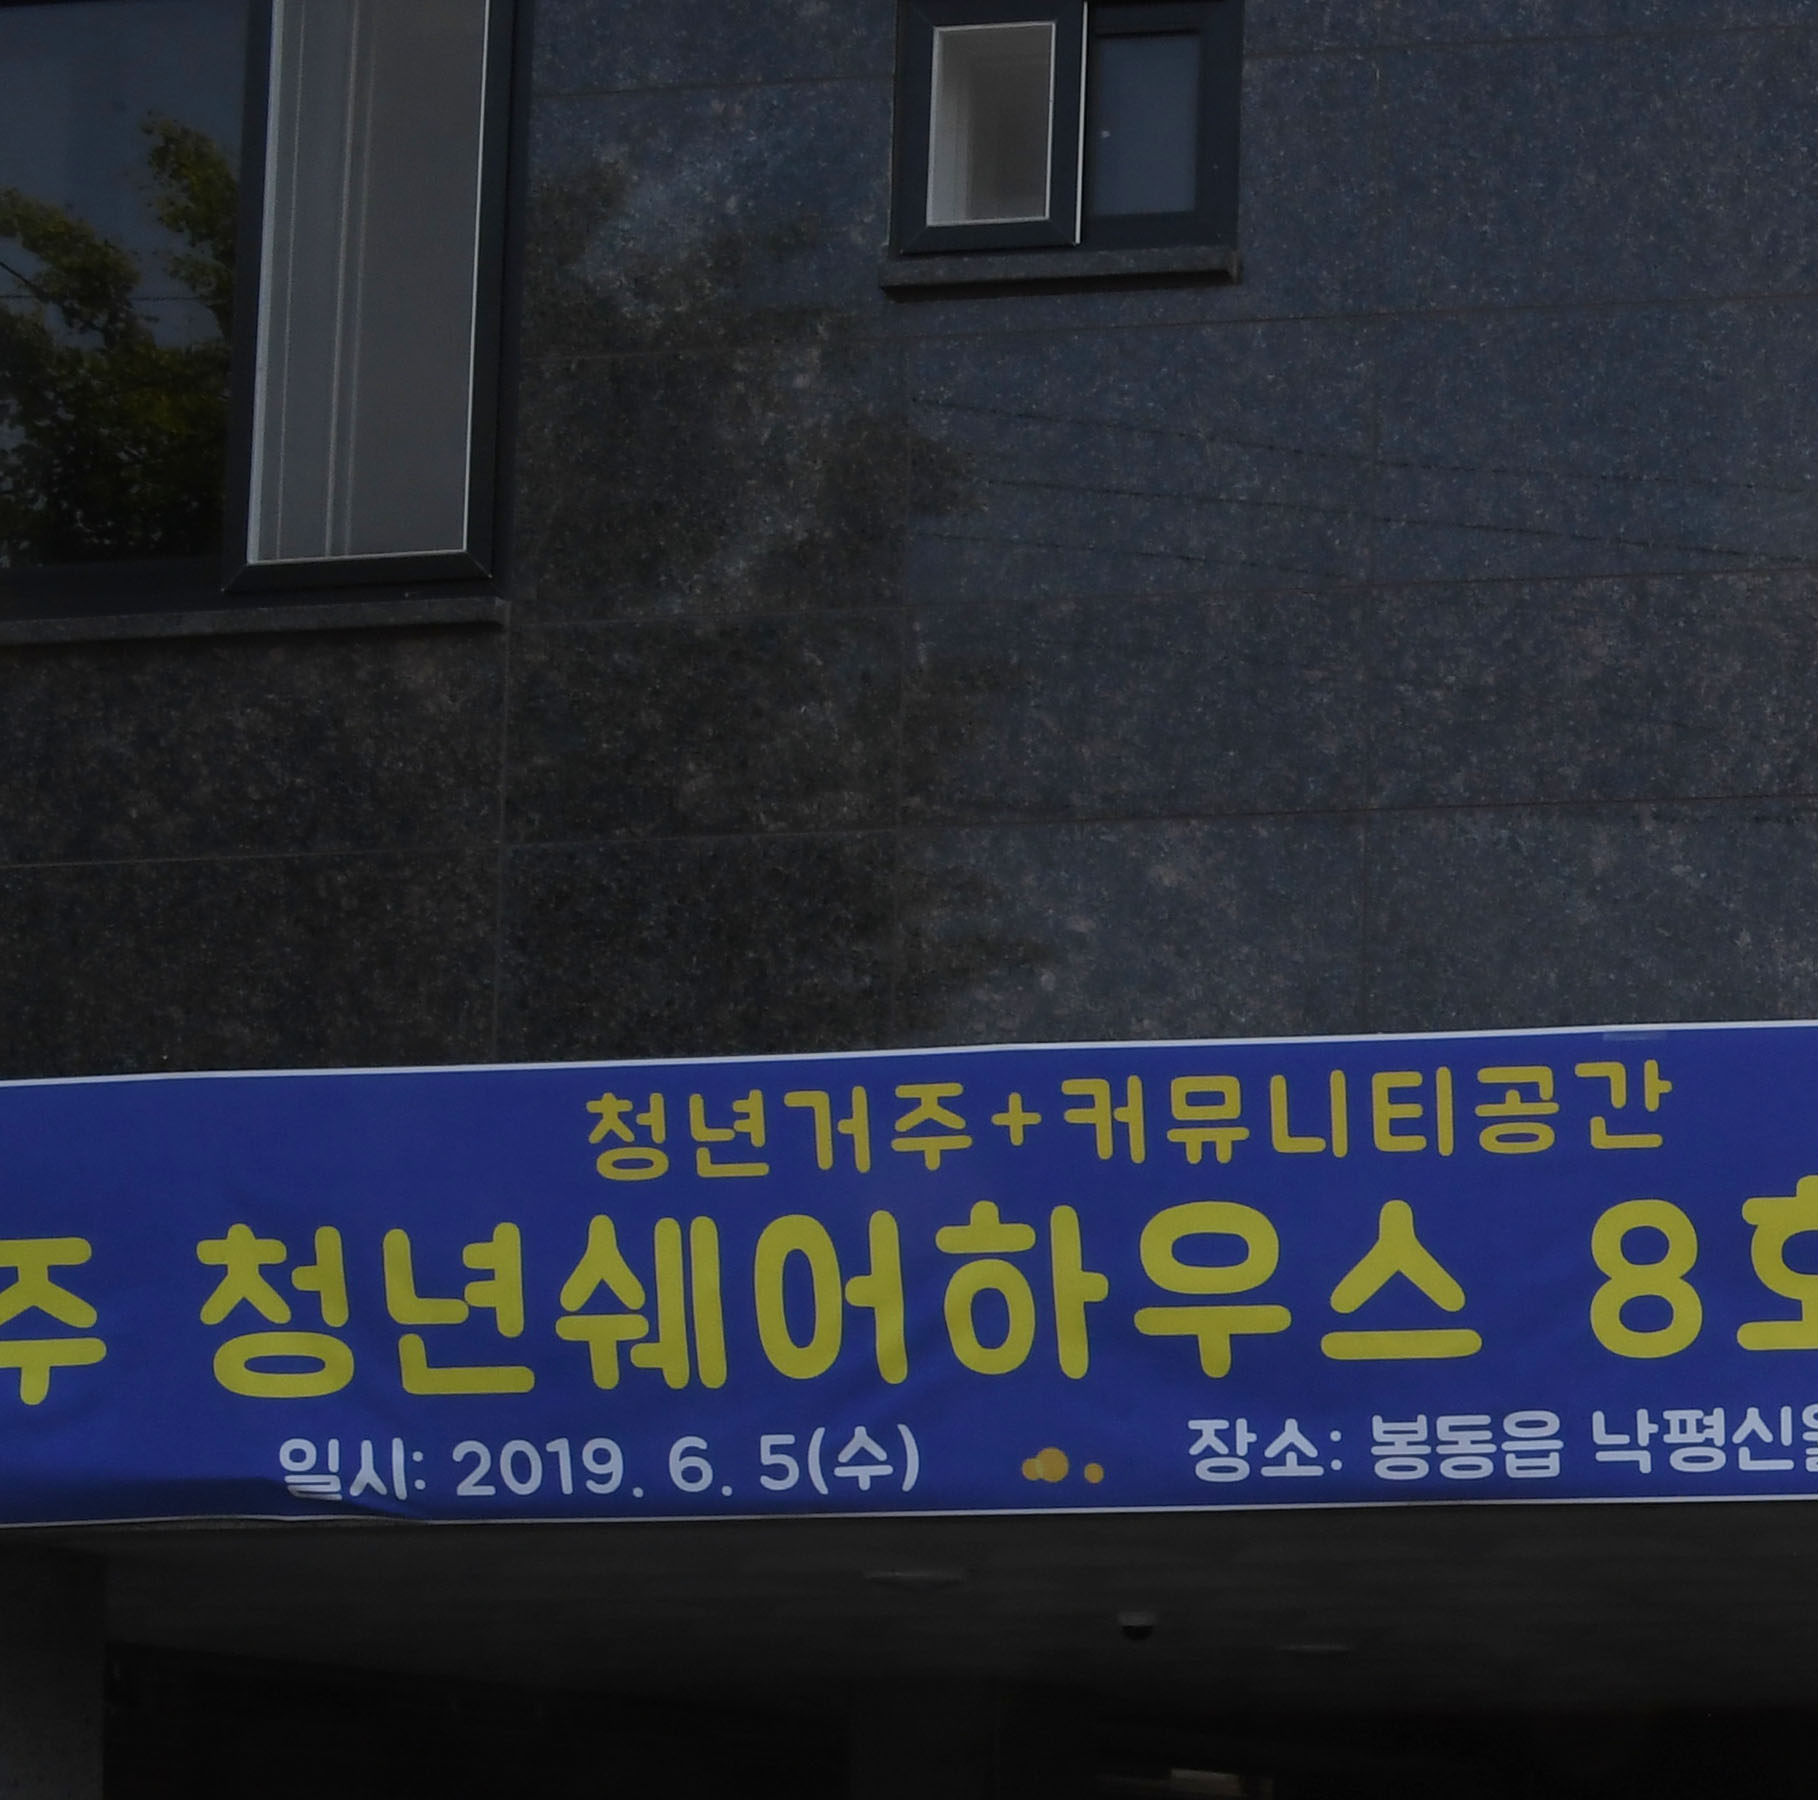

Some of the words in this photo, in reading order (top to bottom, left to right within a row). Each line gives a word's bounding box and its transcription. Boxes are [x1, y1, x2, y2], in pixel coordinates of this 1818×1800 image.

[586, 1059, 1672, 1181] 청년거주+커뮤니티공간
[196, 1200, 1482, 1398] 청년쉐어하우스
[279, 1437, 425, 1500] 일시:
[452, 1438, 643, 1497] 2019.
[669, 1436, 732, 1496] 6.
[760, 1424, 919, 1495] 5(수)
[1188, 1418, 1342, 1482] 장소:
[1371, 1410, 1564, 1480] 봉동읍
